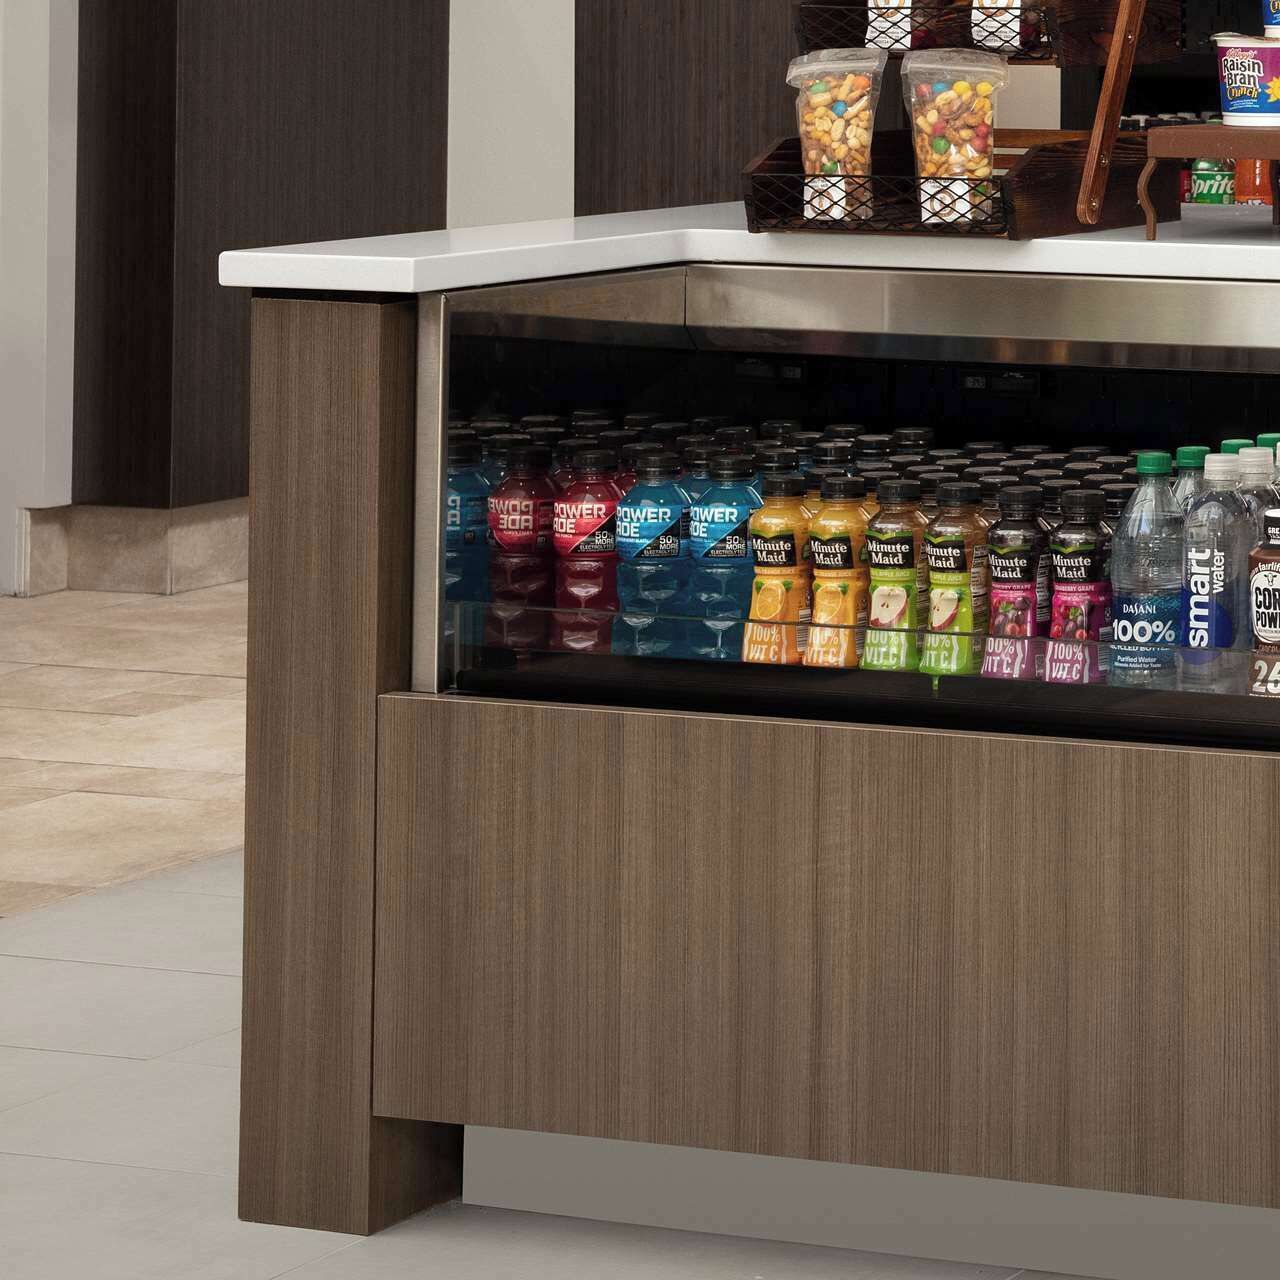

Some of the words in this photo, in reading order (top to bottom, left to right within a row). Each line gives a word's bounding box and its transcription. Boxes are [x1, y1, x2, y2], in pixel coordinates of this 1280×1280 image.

[1223, 58, 1263, 74] Raisin
[1226, 72, 1257, 88] Bran
[1227, 86, 1258, 100] Crunch
[1191, 175, 1236, 198] Sprite
[554, 503, 606, 520] POWER
[616, 506, 671, 522] POWER
[690, 507, 737, 522] POWER
[659, 542, 679, 550] MORE
[752, 538, 792, 551] Minute
[811, 540, 848, 553] Minute
[867, 540, 910, 553] Minute
[926, 543, 961, 557] Minute
[757, 550, 787, 563] Maid
[814, 552, 843, 565] Maid
[871, 552, 903, 565] Maid
[928, 556, 955, 568] Maid
[988, 554, 1027, 567] Minute
[1052, 554, 1092, 567] Minute
[992, 566, 1022, 578] Maid
[1056, 566, 1087, 579] Maid
[1211, 549, 1225, 594] water
[1187, 547, 1211, 649] smart
[1122, 603, 1157, 616] DASANI
[752, 625, 780, 642] 100%
[811, 628, 839, 645] 100%
[867, 630, 899, 644] 100%
[1112, 619, 1176, 643] 100%
[750, 644, 767, 661] VIT
[769, 644, 779, 661] C
[829, 647, 838, 663] C
[866, 648, 884, 664] VIT
[888, 648, 898, 664] C
[940, 651, 949, 666] C
[1053, 643, 1083, 660] 100%
[1117, 655, 1138, 663] Purified
[1002, 657, 1011, 673] C
[1052, 663, 1070, 679] VIT
[1072, 663, 1081, 679] C
